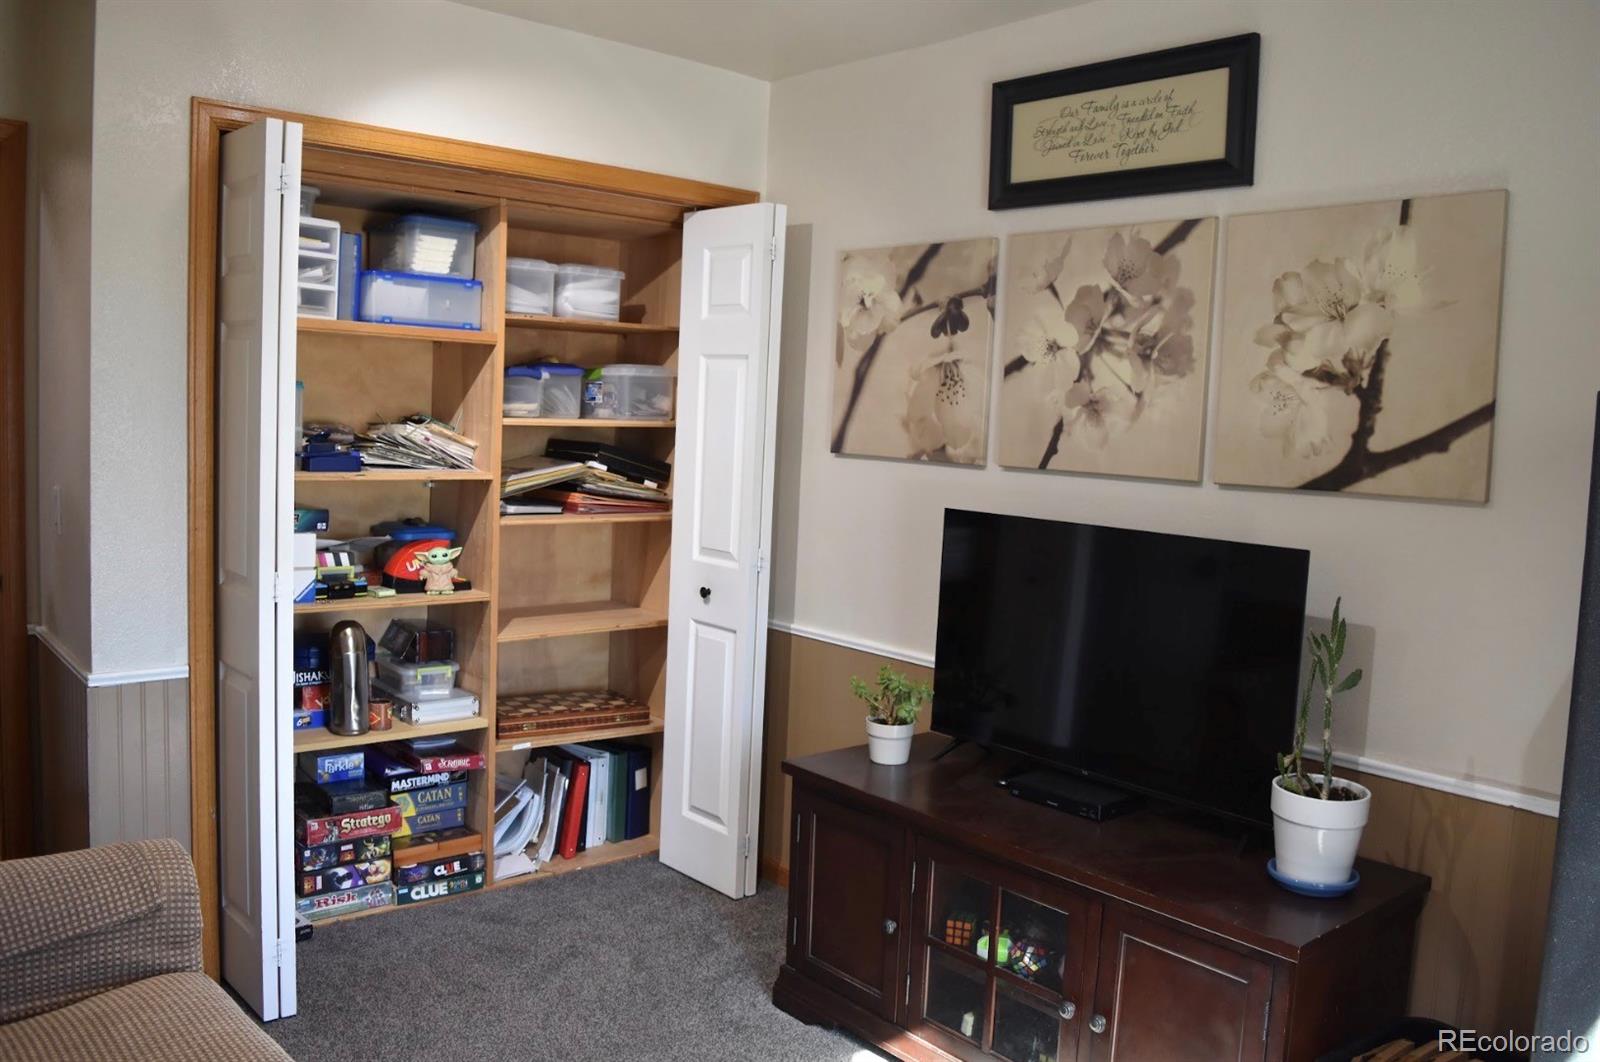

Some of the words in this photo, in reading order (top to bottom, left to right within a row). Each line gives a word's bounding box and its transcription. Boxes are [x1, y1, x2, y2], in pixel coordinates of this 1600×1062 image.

[1081, 93, 1119, 120] Family
[1166, 99, 1198, 119] Faith
[1068, 148, 1109, 163] Forever
[324, 760, 354, 773] Farkle
[391, 772, 450, 792] MASTERMIND
[417, 787, 452, 804] CATAN
[340, 813, 392, 834] Stratego
[417, 814, 441, 825] CATAN
[433, 861, 461, 877] CLUE
[410, 881, 449, 901] CLUE
[314, 892, 358, 910] Risk
